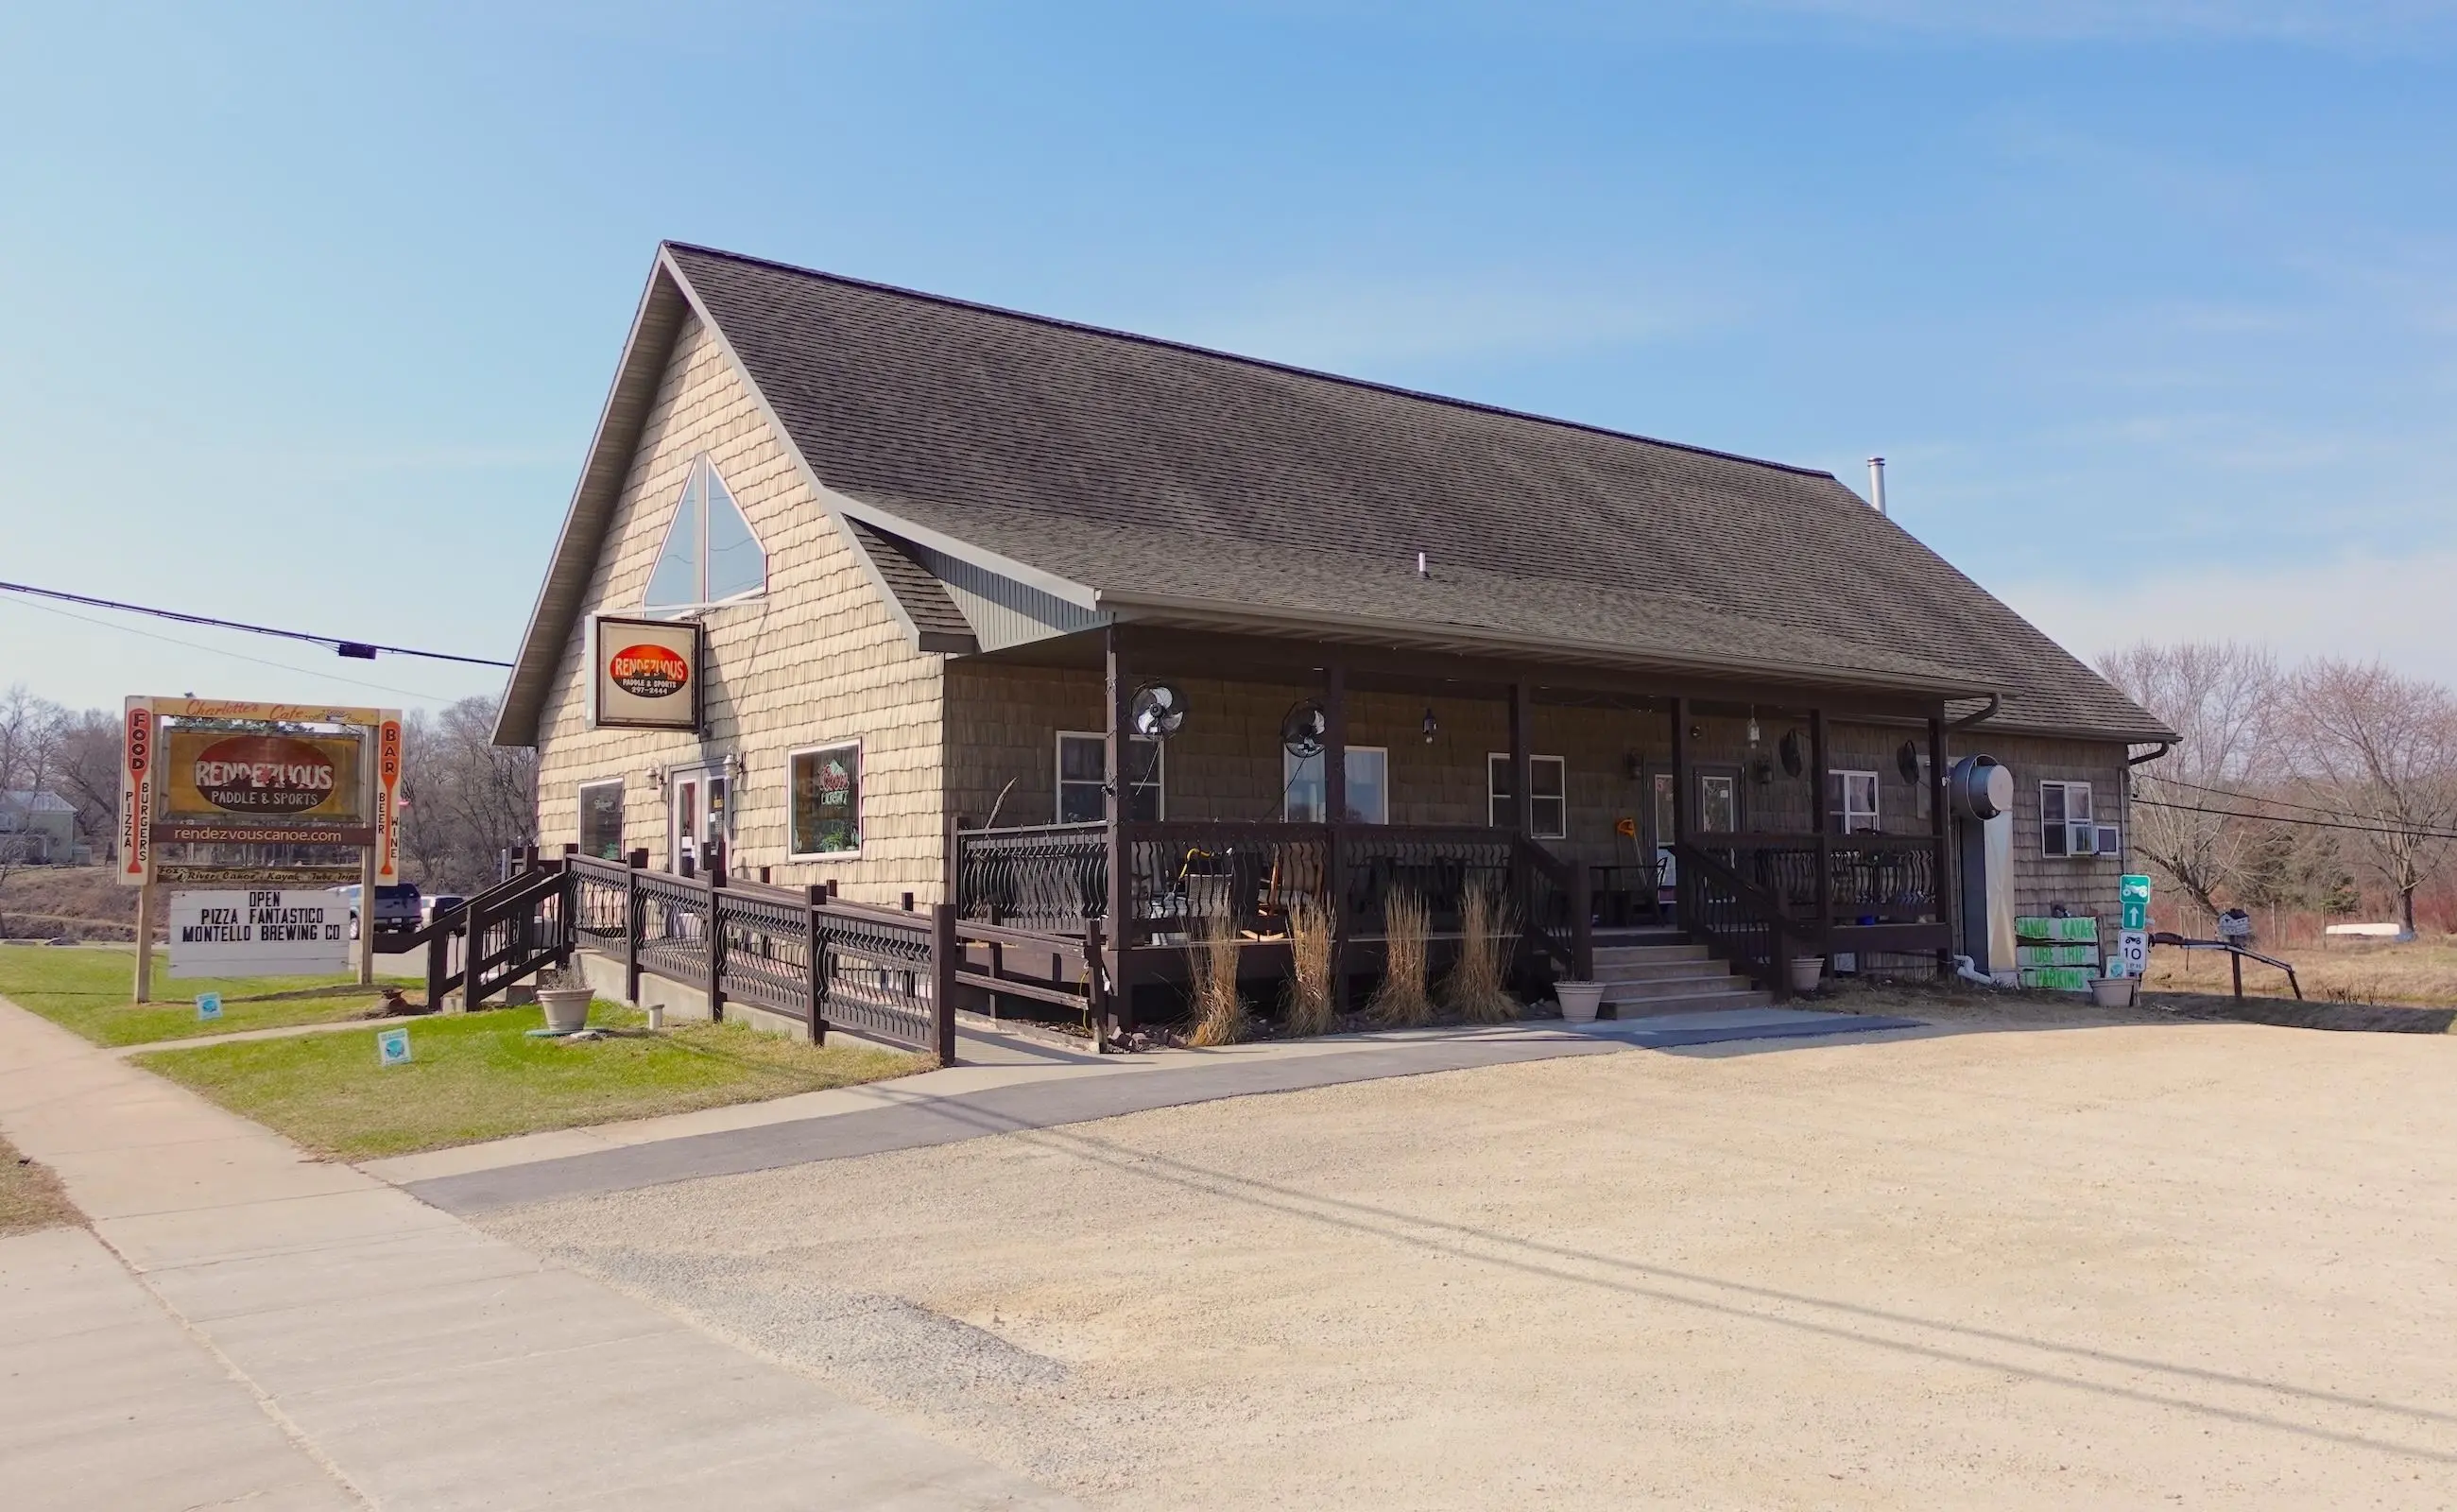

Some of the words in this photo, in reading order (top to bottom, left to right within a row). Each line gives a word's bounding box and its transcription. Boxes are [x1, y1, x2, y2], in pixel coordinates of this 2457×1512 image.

[622, 678, 644, 687] PADDLE
[654, 679, 677, 688] SPORTS
[631, 686, 668, 695] 297-2444
[186, 700, 259, 716] Charlotte's
[131, 713, 147, 770] FOOD
[384, 729, 397, 774] BAR
[211, 790, 257, 805] PADDLE
[261, 792, 270, 805] &
[273, 793, 318, 806] SPORTS
[124, 791, 133, 848] PIZZA
[139, 782, 149, 862] BURGERS
[378, 792, 387, 835] BEER
[174, 826, 341, 842] rendezvouscanoe.com
[390, 816, 399, 859] WINE
[249, 891, 281, 907] OPEN
[201, 908, 238, 925] PIZZA
[249, 907, 323, 924] FANTASTICO
[182, 925, 250, 942] MONTELLO
[261, 924, 318, 941] BREWING
[325, 924, 340, 940] CO
[2061, 918, 2094, 938] KAYAK
[2124, 948, 2141, 960] 10
[2036, 968, 2083, 989] PARKING
